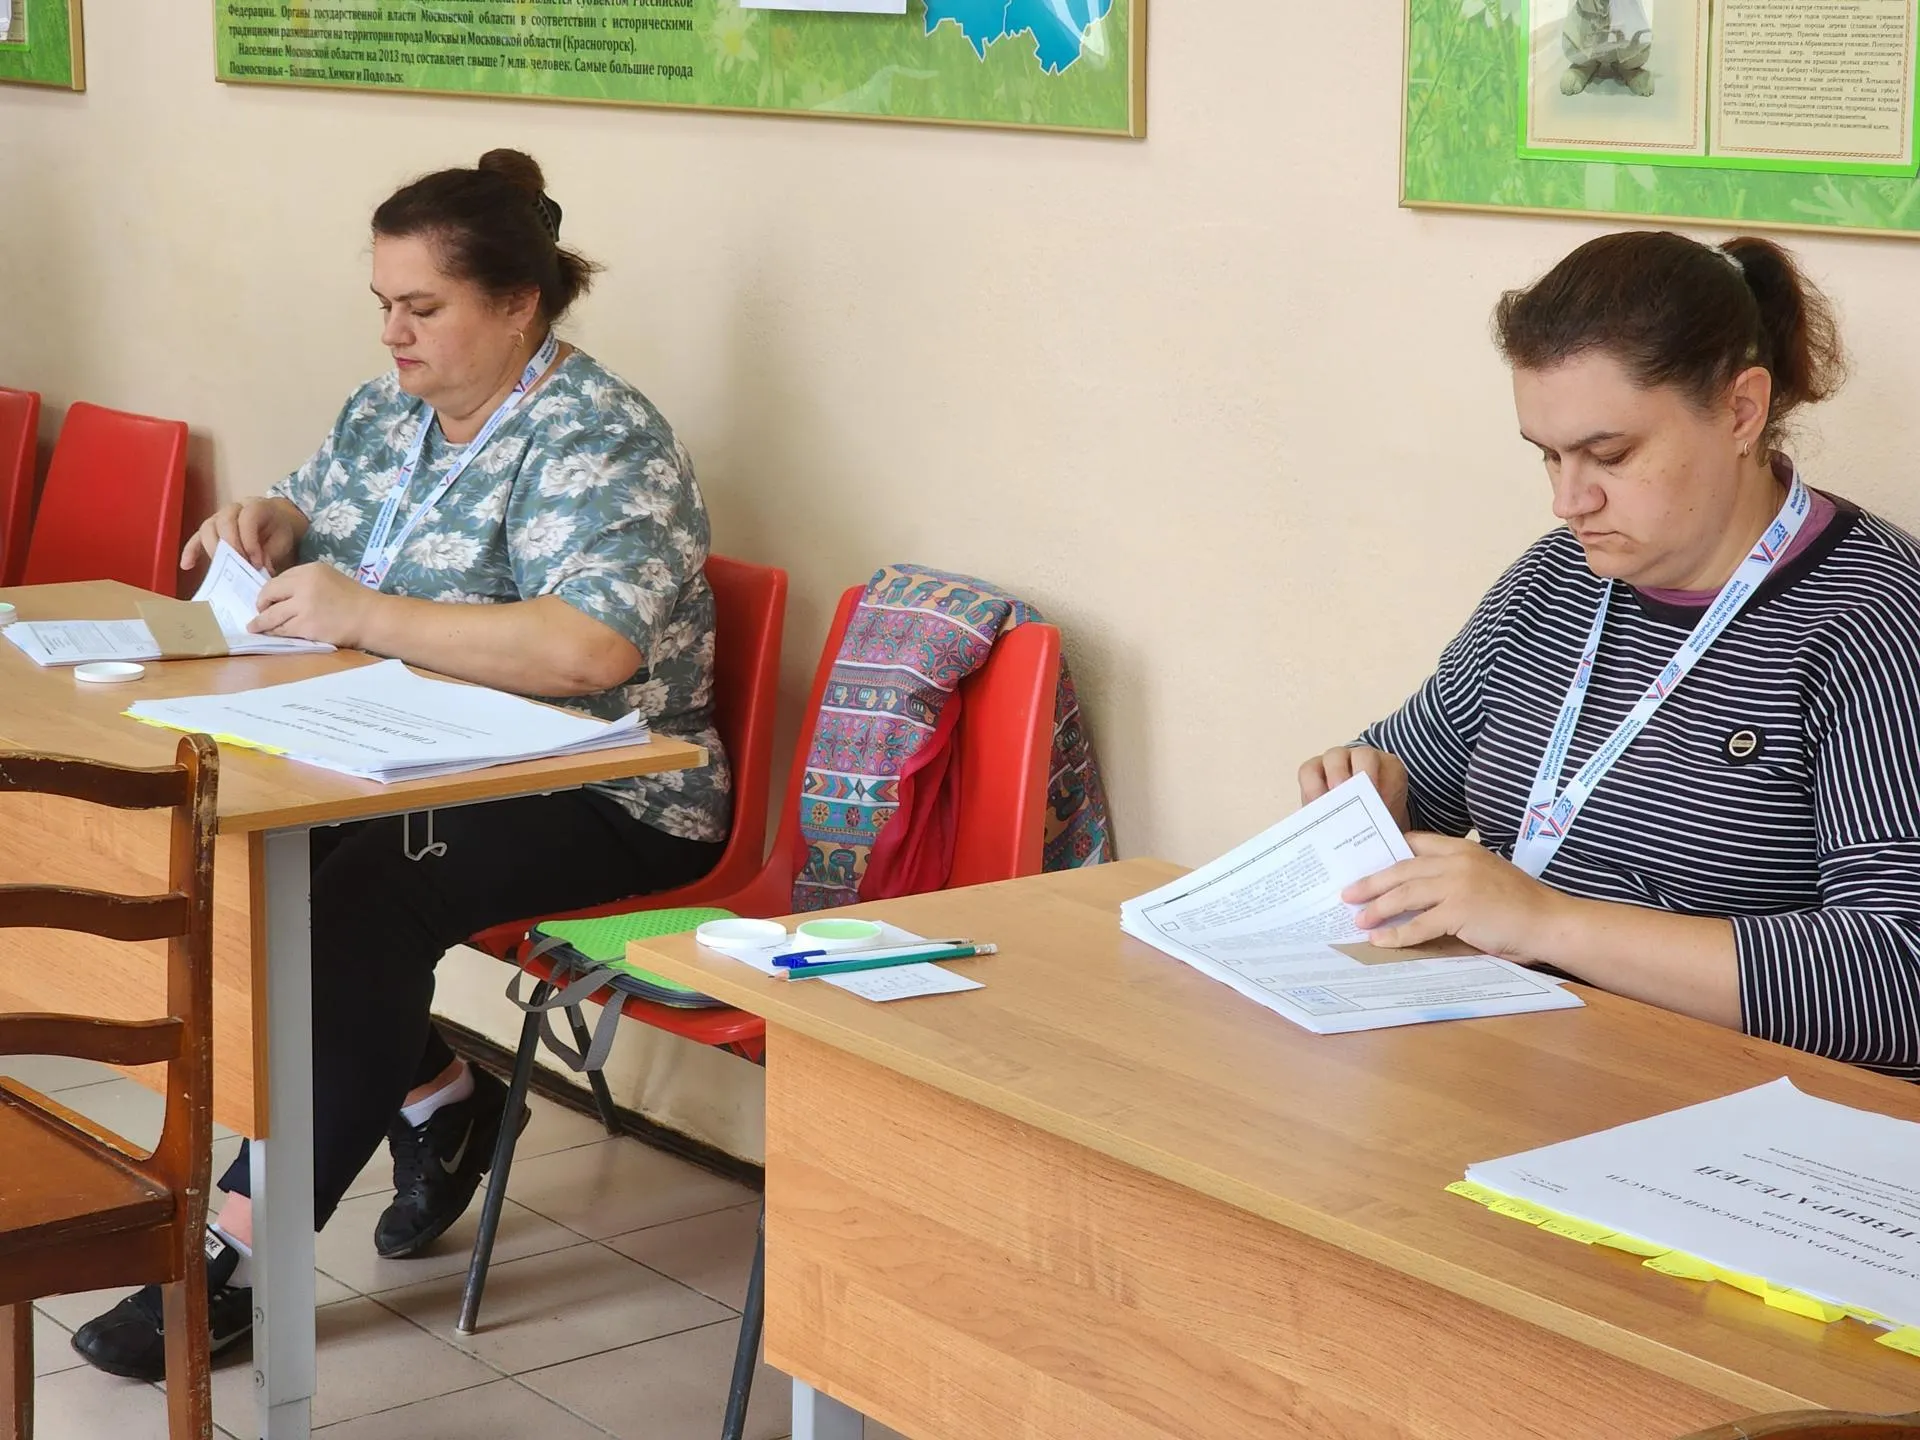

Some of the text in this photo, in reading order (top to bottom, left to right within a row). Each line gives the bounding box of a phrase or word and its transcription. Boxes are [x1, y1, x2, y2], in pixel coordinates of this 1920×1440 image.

[228, 4, 693, 33] Федерации. Органы государственной власти Московской области в соответствии с историческими
[228, 25, 280, 38] традициями
[334, 30, 343, 40] на
[344, 31, 394, 44] территории
[395, 32, 423, 46] города
[424, 29, 459, 44] Москвы
[460, 34, 466, 45] и
[467, 31, 522, 47] Московской
[523, 35, 561, 49] области
[563, 34, 637, 55] (Красногорск).
[229, 61, 283, 76] Подмосковья
[328, 66, 355, 81] Химки
[356, 71, 362, 81] и
[238, 43, 284, 57] Население
[285, 44, 330, 59] Московской
[331, 48, 364, 61] области
[367, 51, 377, 61] на
[379, 48, 399, 63] 2013
[401, 54, 415, 65] год
[416, 54, 465, 67] составляет
[467, 56, 498, 68] свыше
[500, 55, 505, 68] 7
[574, 57, 607, 73] Самые
[609, 59, 654, 75] большие
[657, 64, 693, 80] города
[1688, 580, 1742, 648] ВЫБОРЫ ГУБЕРНАТОРА
[1694, 583, 1751, 653] МОСКОВСКОЙ ОБЛАСТИ
[1542, 749, 1556, 781] ОБЛАСТИ
[1578, 719, 1634, 783] ВЫБОРЫ ГУБЕРНАТОРА
[1583, 720, 1642, 788] МОСКОВСКОЙ ОБЛАСТИ
[1561, 797, 1572, 814] 23
[1605, 1173, 1682, 1201] ОБЛАСТИ
[1693, 1165, 1918, 1239] ИЗБИРАТЕЛЕЙ
[1682, 1199, 1803, 1240] МОСКОВСКОЙ
[1825, 1229, 1887, 1254] сентября
